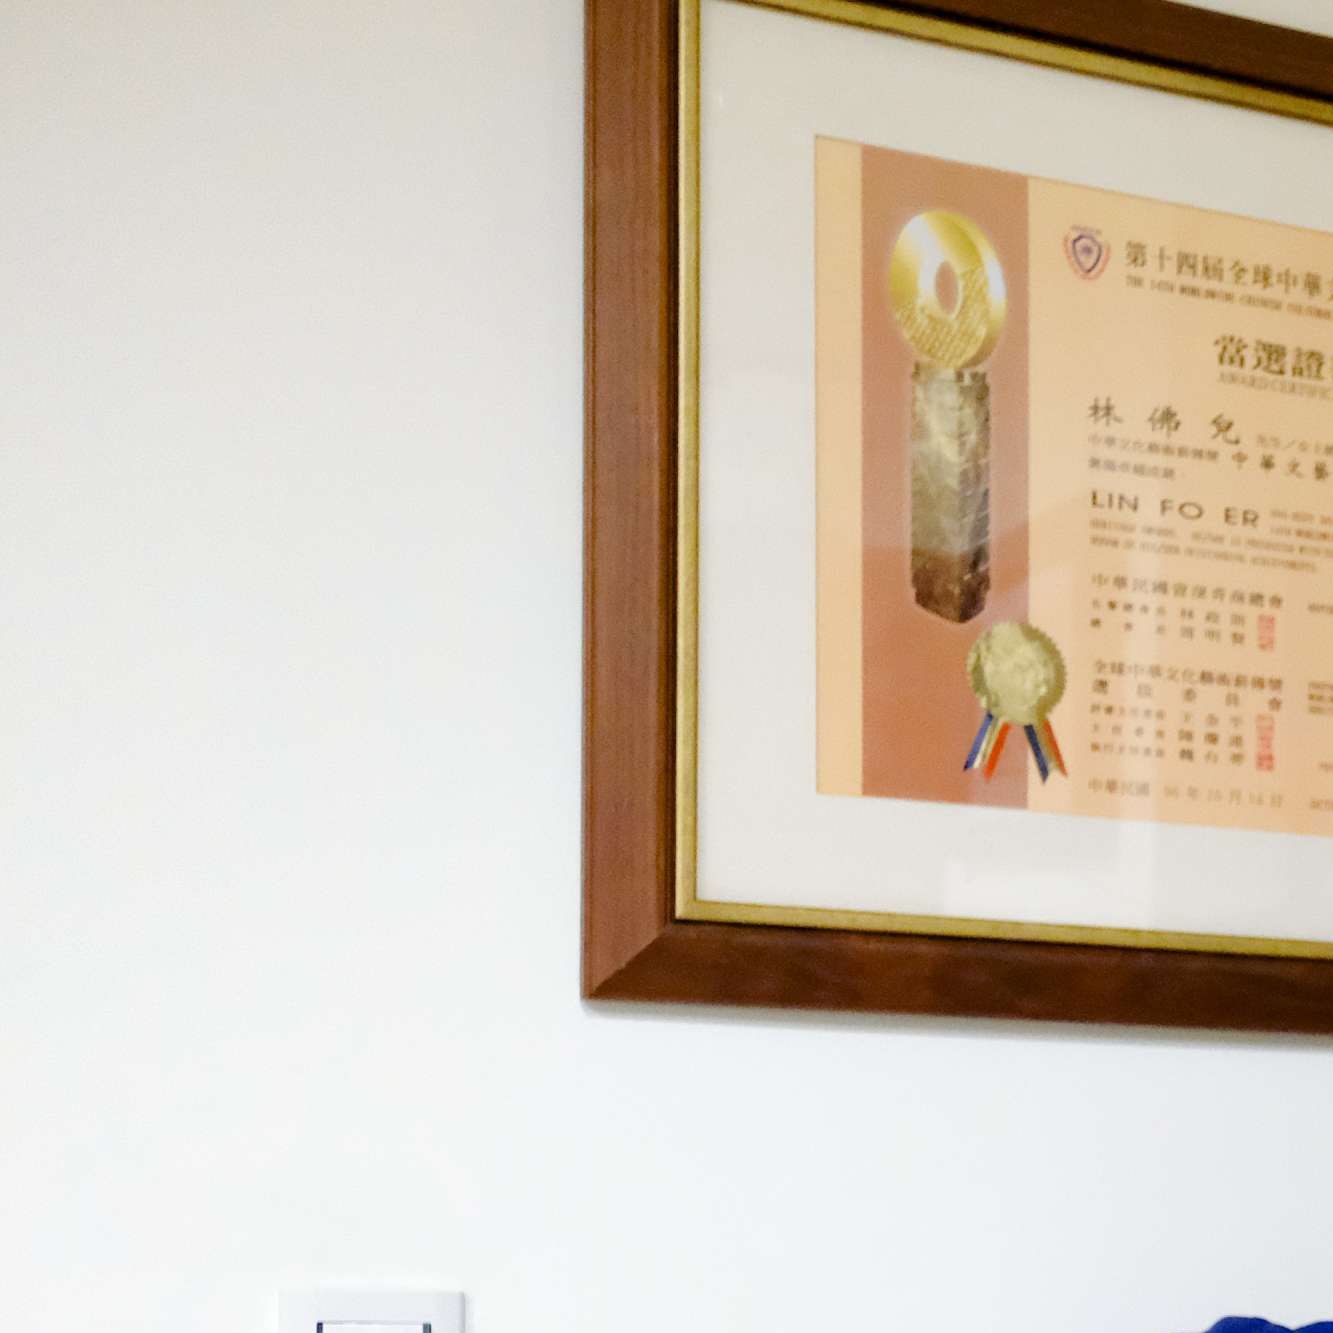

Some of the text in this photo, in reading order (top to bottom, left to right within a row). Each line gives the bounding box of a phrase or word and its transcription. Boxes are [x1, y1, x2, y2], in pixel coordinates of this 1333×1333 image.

[1091, 489, 1139, 513] LIN
[1160, 498, 1204, 520] FO
[1224, 506, 1260, 528] ER
